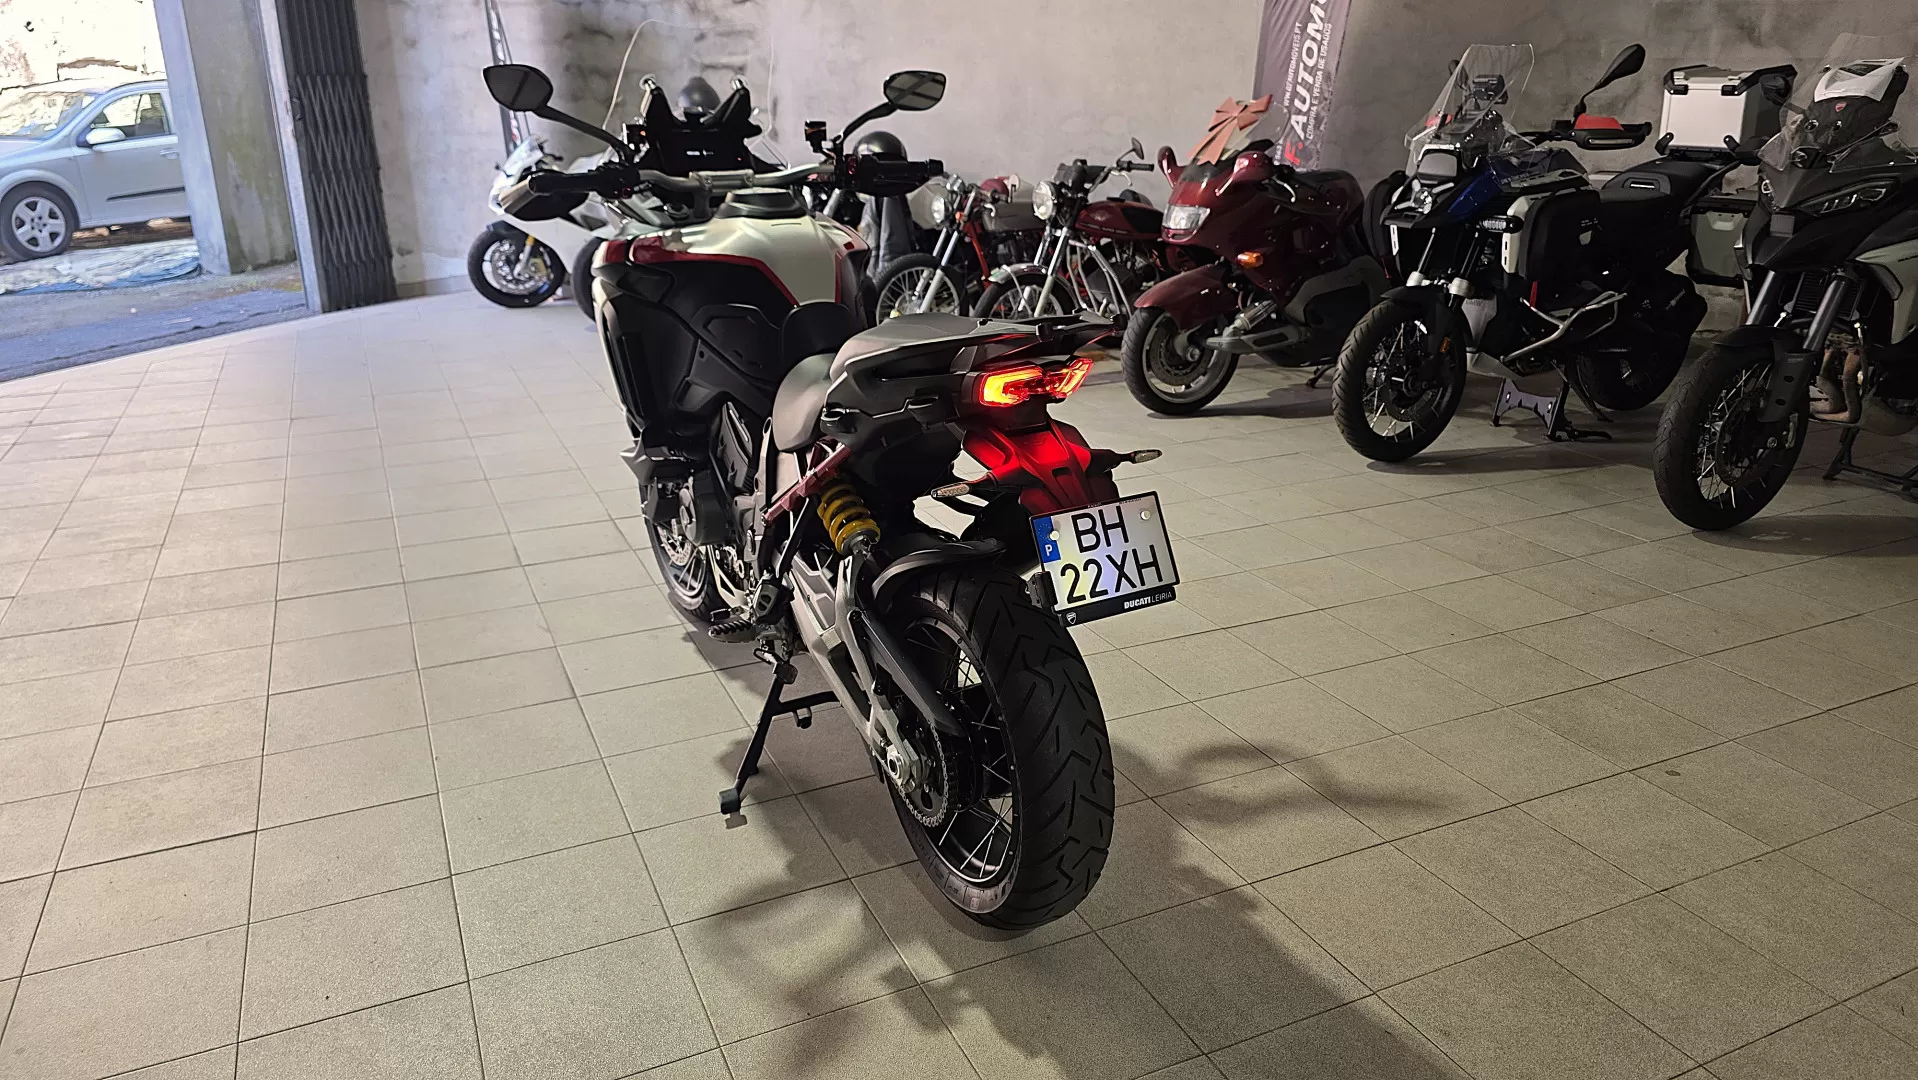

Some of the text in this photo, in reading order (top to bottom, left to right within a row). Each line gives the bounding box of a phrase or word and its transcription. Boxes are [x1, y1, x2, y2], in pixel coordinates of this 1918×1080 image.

[1320, 23, 1332, 57] USADOS
[1290, 0, 1327, 140] AUTOM
[1318, 57, 1326, 69] DE
[1313, 72, 1323, 97] VENDA
[1306, 106, 1318, 140] COMPRA
[1071, 505, 1129, 553] BH
[1044, 544, 1053, 557] P
[1060, 544, 1163, 605] 22XH
[1124, 591, 1173, 609] DUCATI LEIRIA
